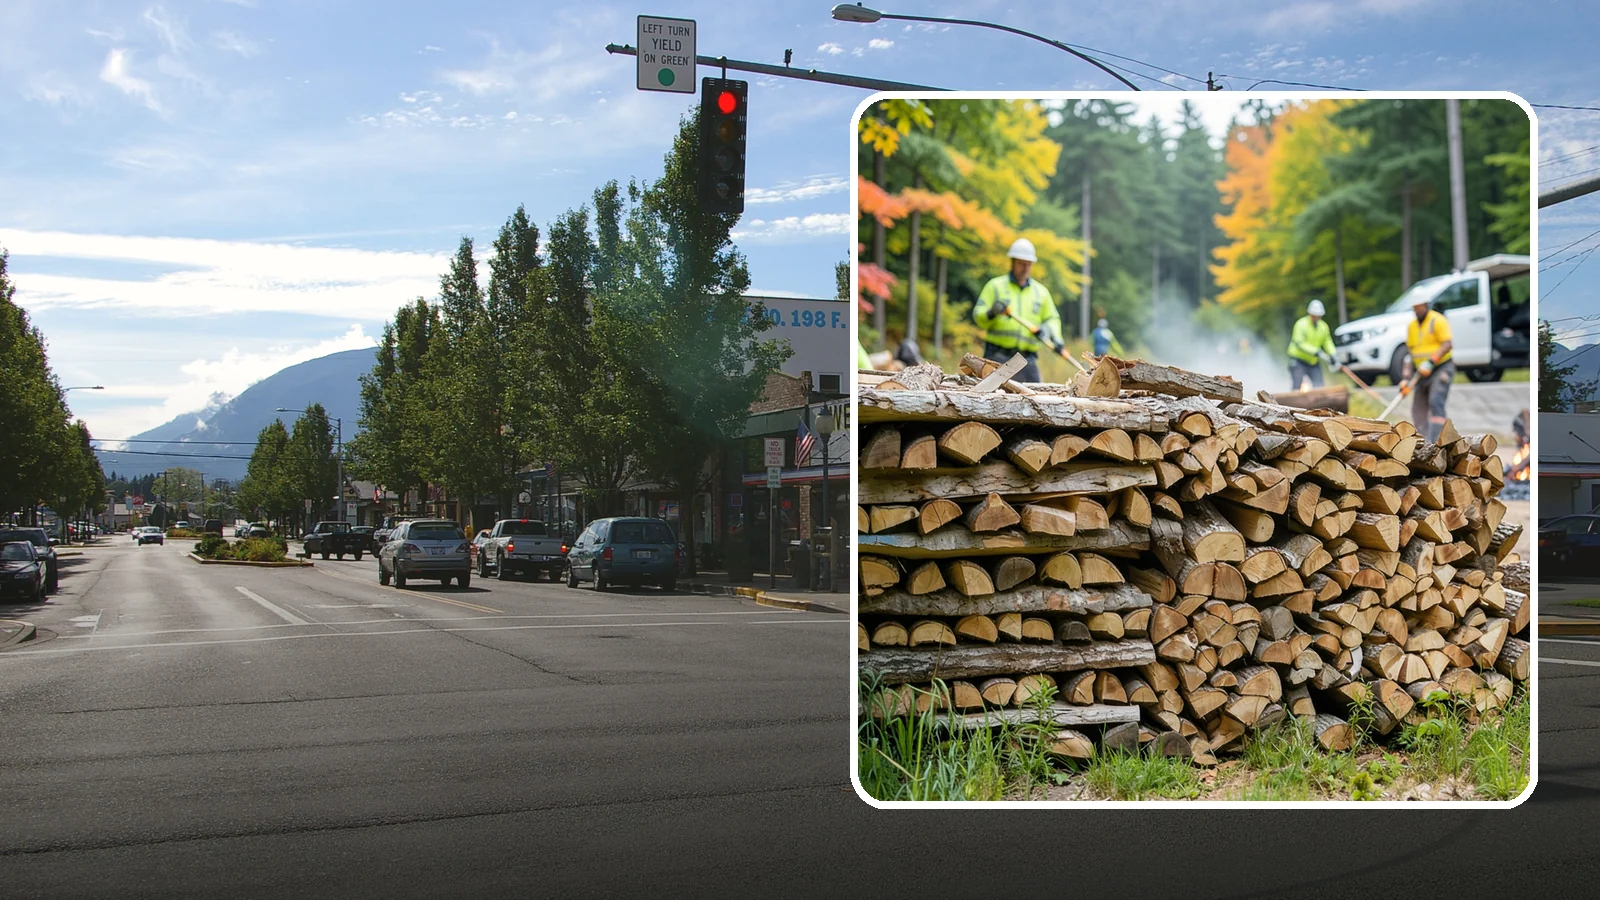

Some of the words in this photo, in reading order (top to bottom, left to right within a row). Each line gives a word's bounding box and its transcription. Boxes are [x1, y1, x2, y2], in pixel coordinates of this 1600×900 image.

[643, 23, 663, 34] LEFT
[668, 26, 690, 37] TURN
[652, 38, 682, 51] YIELD
[644, 53, 656, 63] ON
[661, 55, 688, 66] GREEN
[791, 309, 826, 328] 198
[831, 311, 847, 329] F.
